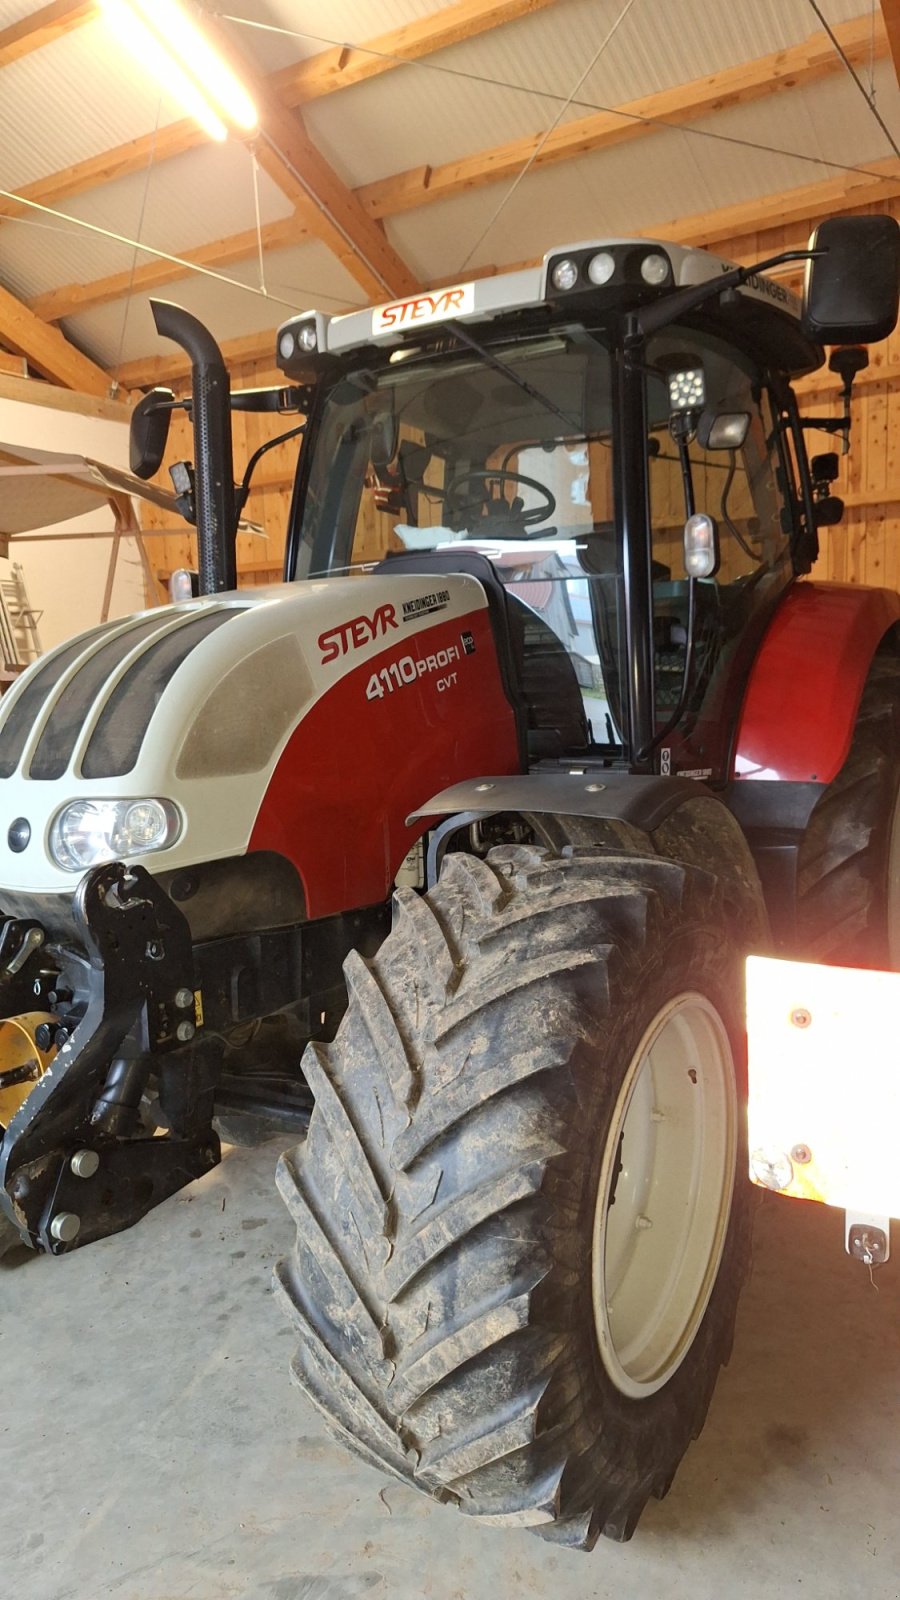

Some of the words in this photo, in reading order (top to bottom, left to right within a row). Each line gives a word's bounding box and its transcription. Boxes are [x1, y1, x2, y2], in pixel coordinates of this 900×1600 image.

[380, 289, 465, 327] STEYR
[402, 593, 438, 615] KNEIDINGER
[317, 603, 399, 665] STEYR
[436, 672, 458, 692] CVT
